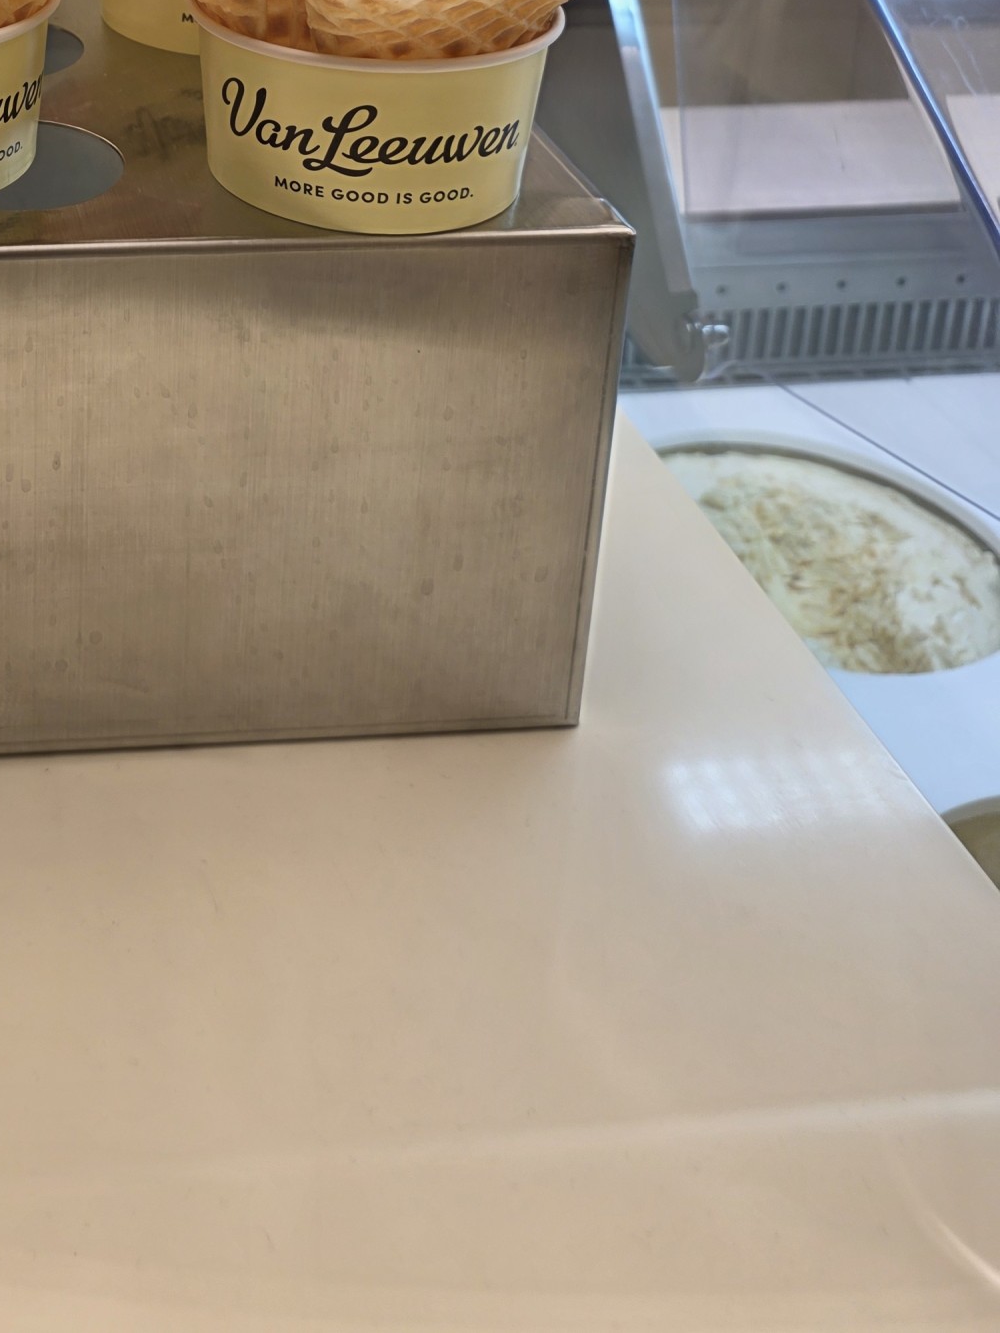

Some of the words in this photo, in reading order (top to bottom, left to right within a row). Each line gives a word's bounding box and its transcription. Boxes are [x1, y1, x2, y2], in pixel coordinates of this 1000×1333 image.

[221, 77, 321, 156] Van
[274, 175, 325, 199] MORE
[331, 188, 389, 205] GOOD
[396, 192, 413, 205] IS
[419, 186, 475, 205] GOOD.
